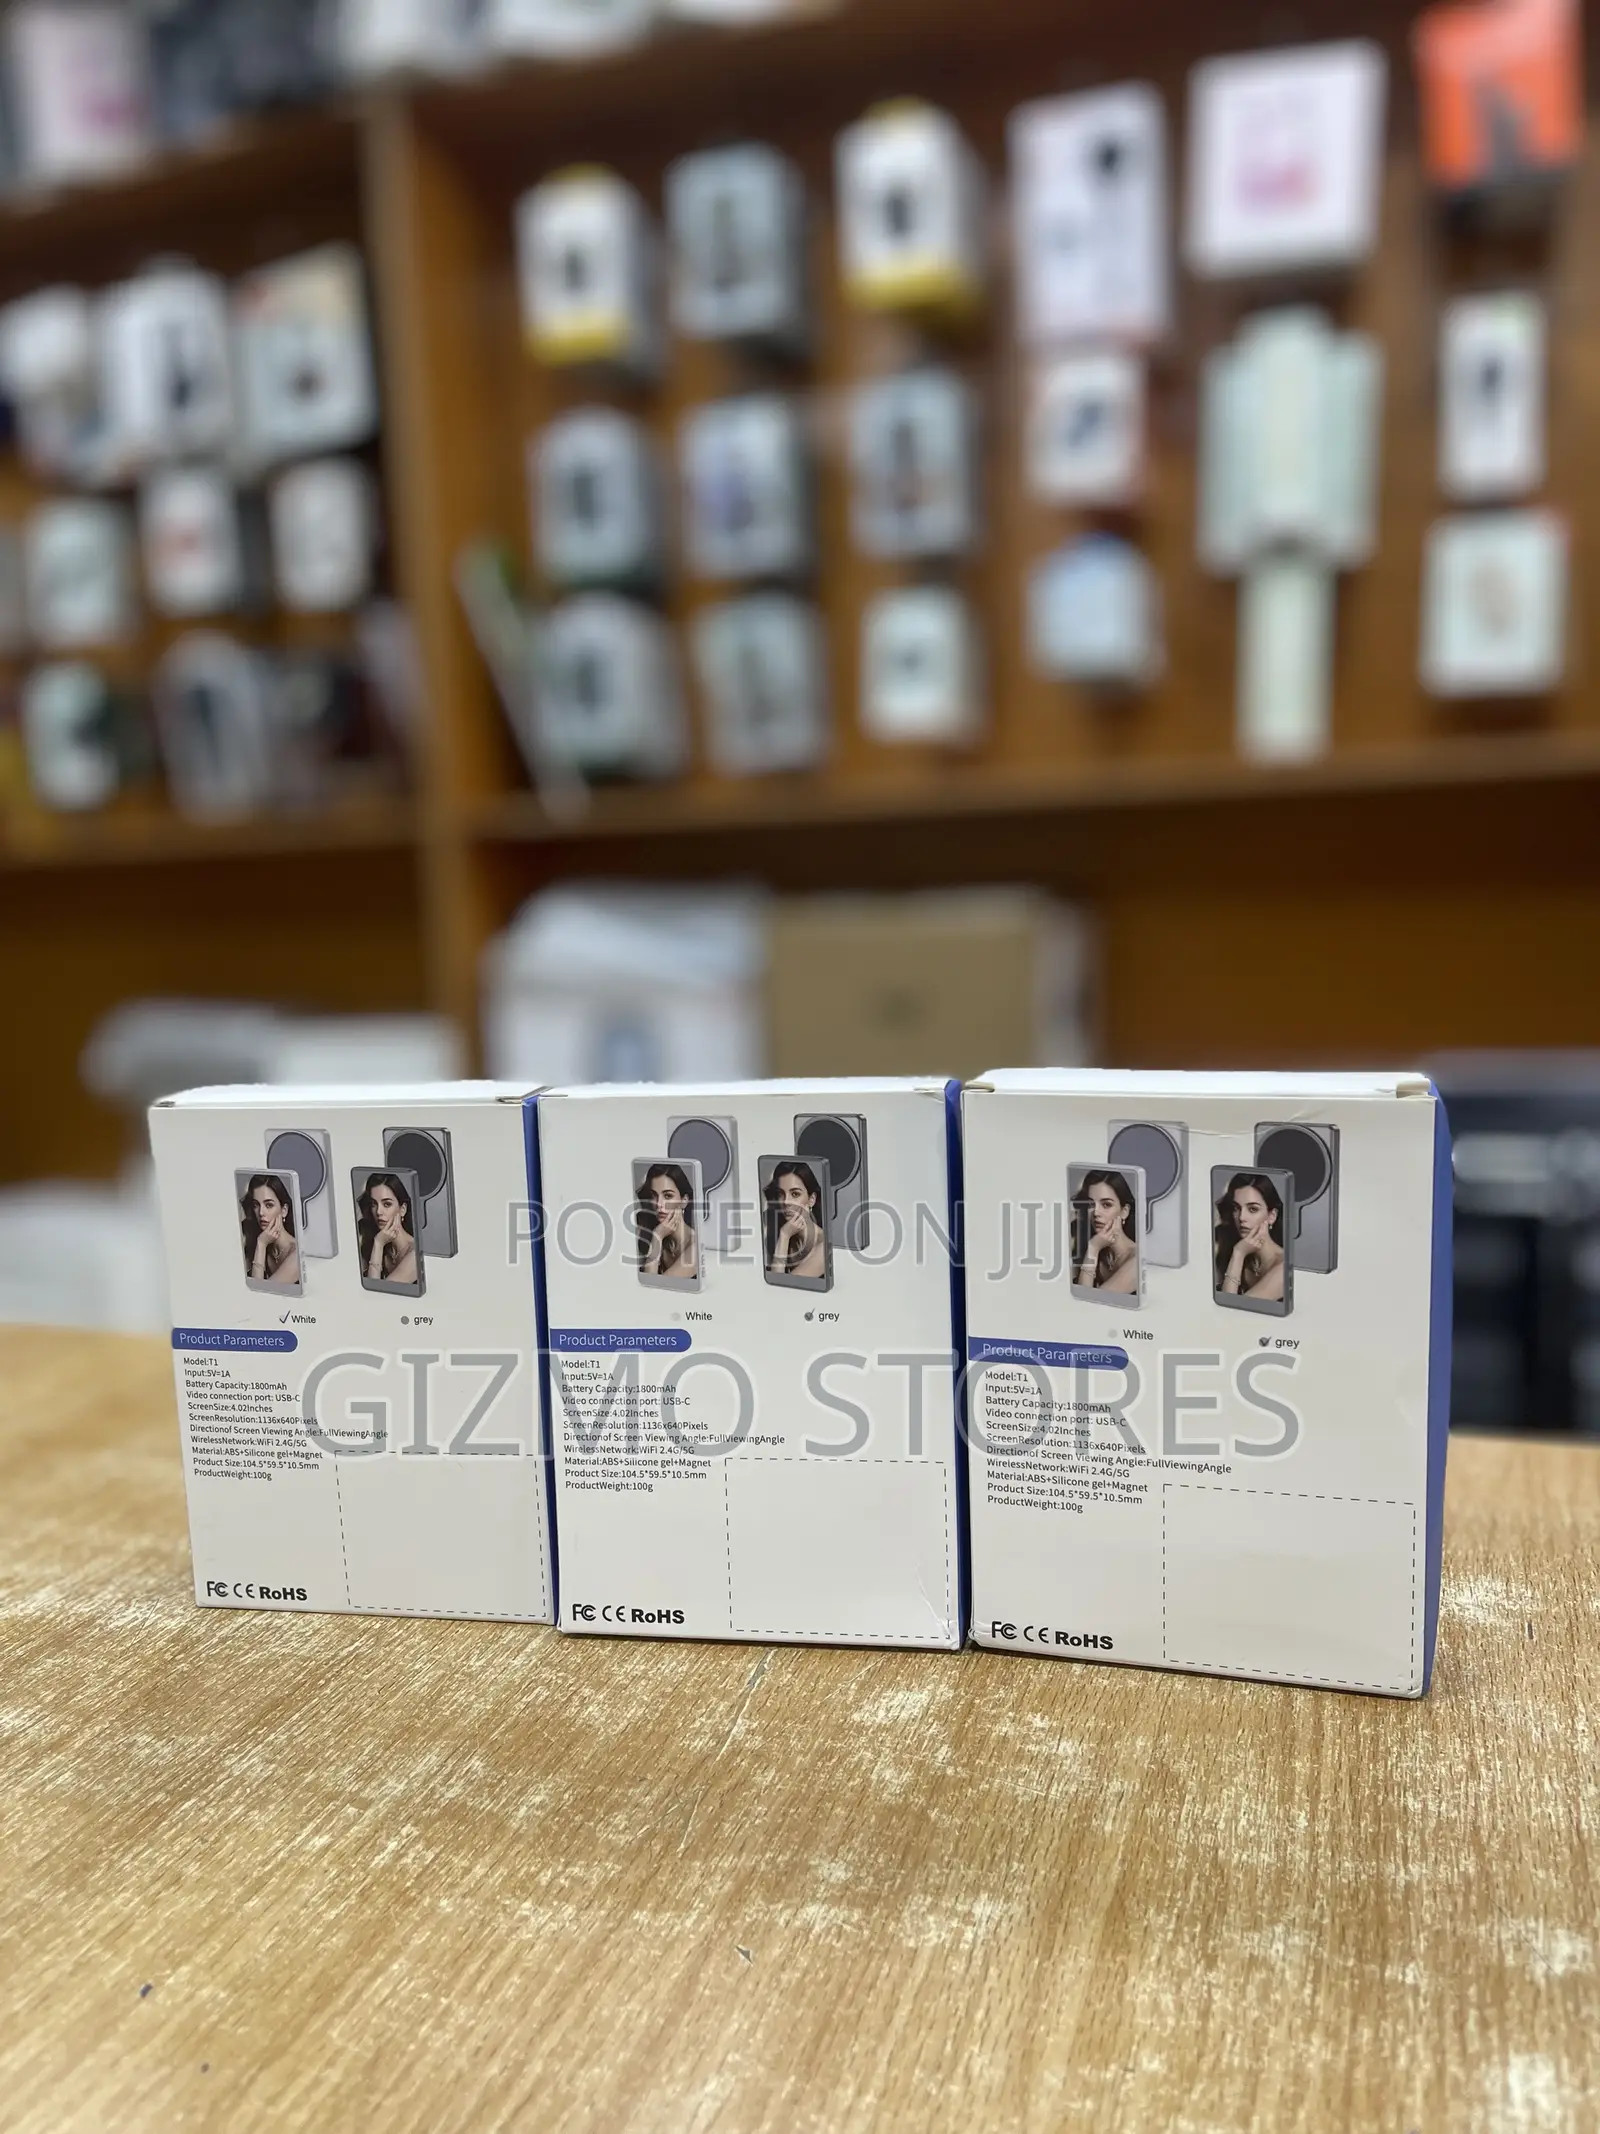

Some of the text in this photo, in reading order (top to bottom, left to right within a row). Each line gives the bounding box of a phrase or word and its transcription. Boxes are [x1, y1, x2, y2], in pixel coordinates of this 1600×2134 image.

[291, 1315, 316, 1323] White
[414, 1316, 433, 1326] grey
[685, 1312, 713, 1321] White
[818, 1313, 840, 1322] grey
[179, 1333, 284, 1346] Product Parameters
[559, 1335, 677, 1346] Product Parameters
[1123, 1329, 1154, 1341] White
[1275, 1338, 1300, 1349] grey
[983, 1344, 1112, 1363] Product Parameters
[184, 1358, 218, 1366] Model:T1
[561, 1360, 600, 1368] Model:T1
[985, 1371, 1028, 1381] Model:T1
[186, 1380, 287, 1391] Battery Capacity:1800mAh
[562, 1385, 676, 1394] Battery Capacity:1800mAh
[187, 1391, 208, 1399] Video
[210, 1392, 252, 1401] connection
[254, 1394, 273, 1402] port:
[562, 1397, 690, 1407] Video connection port: USB-C
[188, 1403, 272, 1413] ScreenSize:4.02Inches
[986, 1396, 1111, 1413] Battery Capacity:1800mAh
[563, 1409, 659, 1417] ScreenSize:4.02Inches
[986, 1409, 1127, 1427] Video connection port: USB-C
[189, 1413, 318, 1425] ScreenResolution:1136x640Pixels
[563, 1421, 708, 1430] ScreenResolution:1136x640Pixels
[986, 1421, 1091, 1436] ScreenSize:4.02Inches
[190, 1425, 388, 1439] Directionof Screen Viewing Angle:FullViewingAngle
[191, 1435, 307, 1447] WirelessNetwork:WiFi 2.4G/5G
[564, 1433, 785, 1445] Directionof Screen Viewing Angle:FullViewingAngle
[986, 1433, 1146, 1454] ScreenResolution:1136x640Pixels
[192, 1447, 323, 1459] Material:ABS+Silicone gel+Magnet
[564, 1445, 695, 1454] WirelessNetwork:WiFi 2.4G/5G
[193, 1458, 223, 1466] Product
[565, 1457, 711, 1468] Material:ABS+Silicone gel+Magnet
[987, 1446, 1232, 1474] Directionof Screen Viewing Angle:FullViewingAngle
[565, 1469, 600, 1478] Product
[987, 1458, 1129, 1478] WirelessNetwork:WiFi 2.4G/5G
[194, 1469, 272, 1481] ProductWeight:100g
[565, 1481, 653, 1492] ProductWeight:100g
[987, 1470, 1148, 1493] Material:ABS+Silicone gel+Magnet
[987, 1482, 1024, 1494] Product
[988, 1495, 1083, 1513] ProductWeight:100g
[259, 1586, 307, 1601] RoHS
[631, 1608, 685, 1624] RoHS
[1055, 1631, 1113, 1650] RoHS
